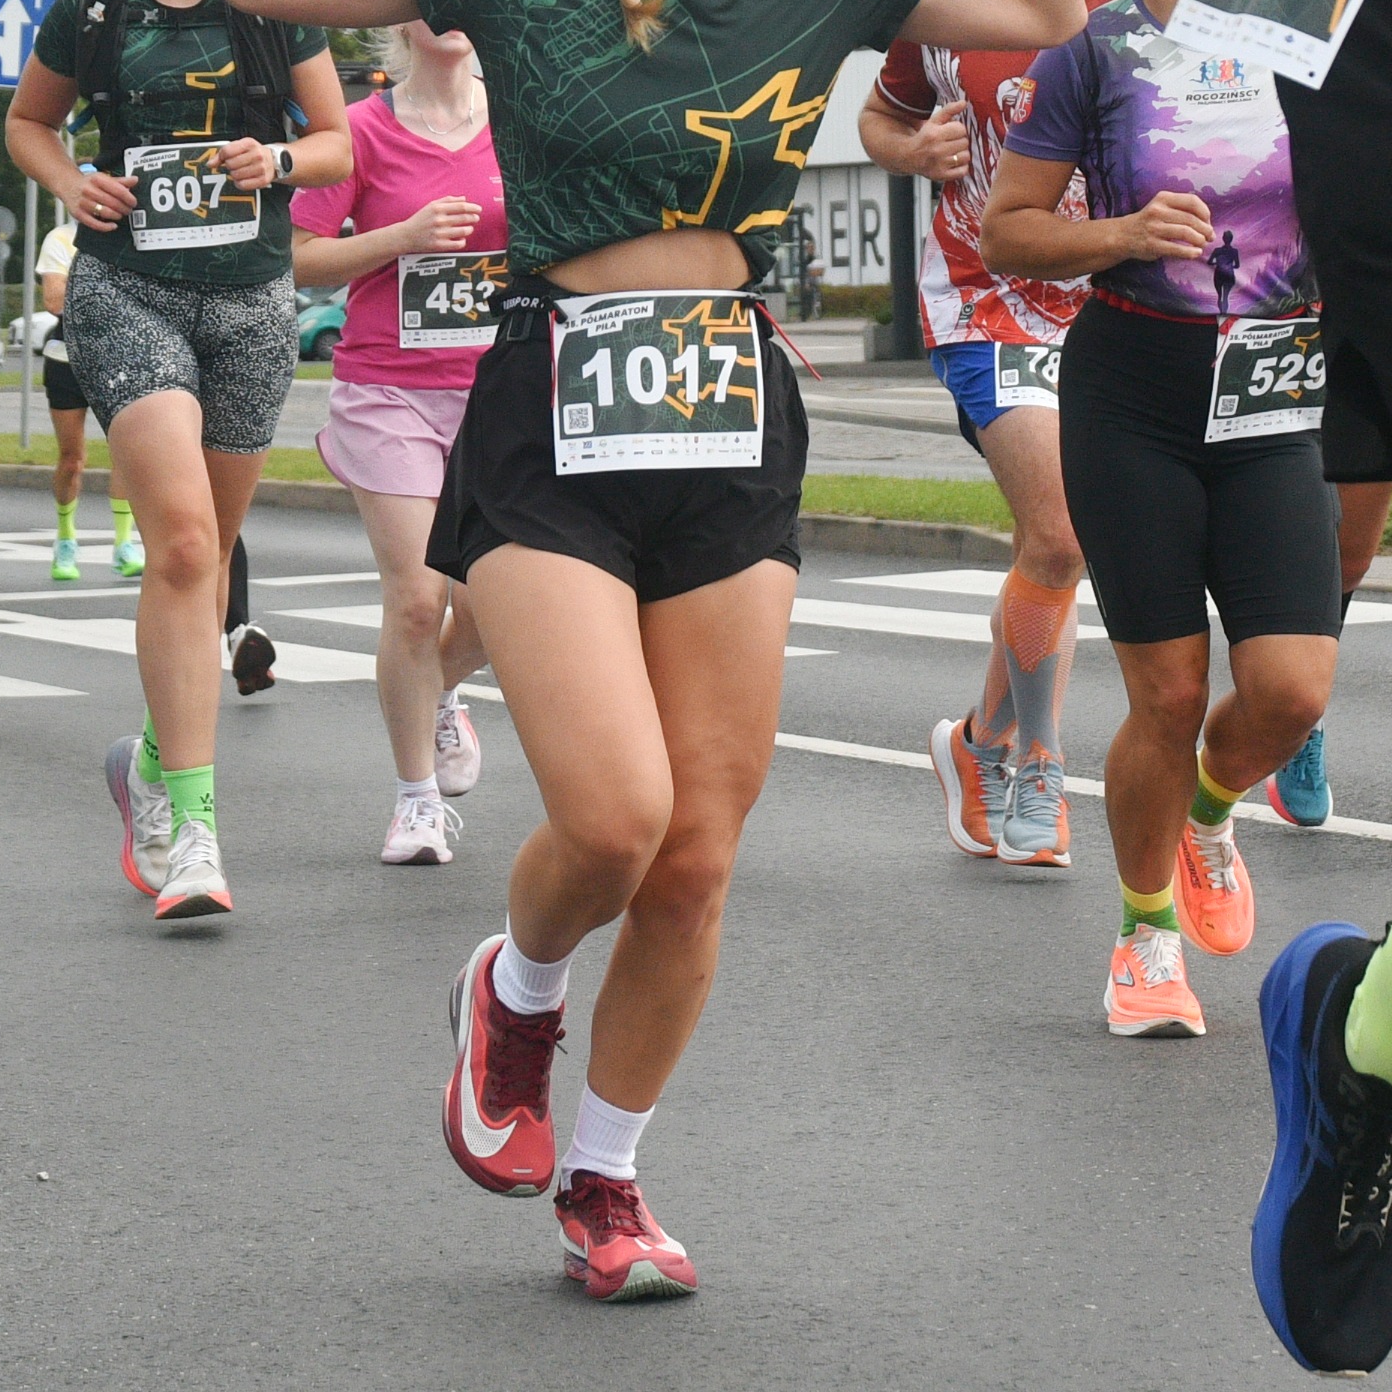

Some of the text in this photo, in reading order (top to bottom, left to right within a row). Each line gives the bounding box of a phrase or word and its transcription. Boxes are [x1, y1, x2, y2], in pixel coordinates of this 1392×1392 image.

[1185, 88, 1261, 102] ROGOZIŃSCY
[150, 173, 227, 213] 607
[425, 280, 496, 314] 453
[580, 304, 649, 327] PÓŁMARATON
[595, 319, 618, 333] PIŁA
[1241, 329, 1291, 341] PÓŁMARATON
[1252, 339, 1269, 347] PIŁA
[581, 344, 738, 407] 1017
[1248, 351, 1327, 397] 529
